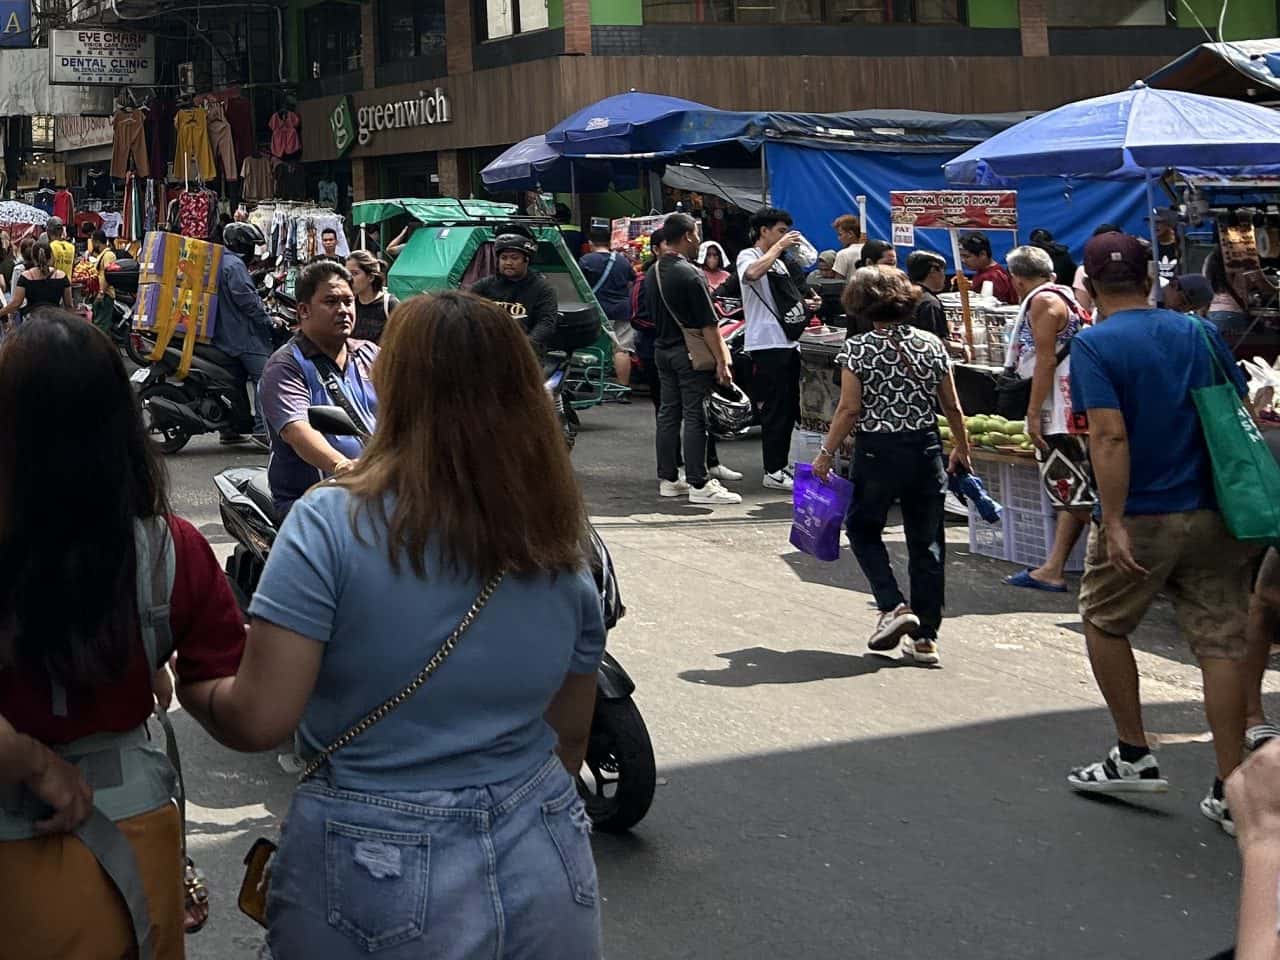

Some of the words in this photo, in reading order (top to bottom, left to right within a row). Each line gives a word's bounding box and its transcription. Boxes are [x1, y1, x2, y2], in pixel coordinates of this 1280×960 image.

[79, 32, 100, 42] EYE
[62, 57, 106, 68] DENTAL
[111, 59, 148, 69] CLINIC
[358, 87, 449, 145] greenwich
